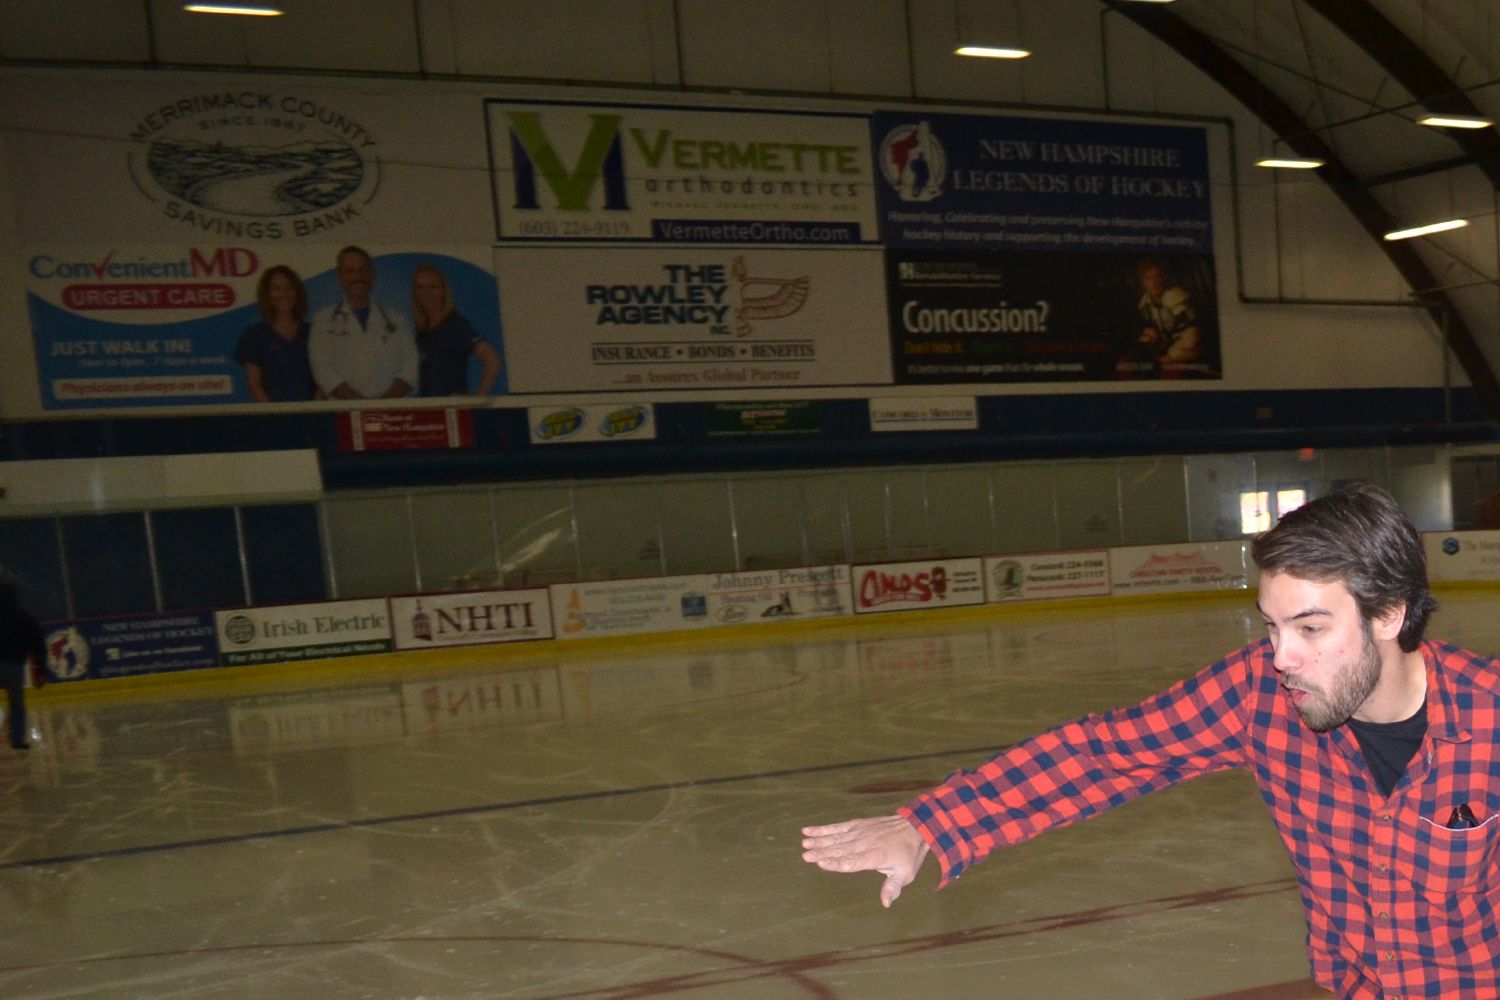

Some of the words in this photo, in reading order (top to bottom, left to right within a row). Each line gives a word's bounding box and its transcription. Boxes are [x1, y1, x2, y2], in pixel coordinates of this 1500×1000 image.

[129, 91, 273, 144] MERRIMACK
[279, 96, 377, 150] COUNTY
[630, 127, 863, 175] VERMETTE
[979, 138, 1033, 161] NEW
[1040, 142, 1182, 168] HAMPSHIRE
[645, 176, 859, 197] orthodontics
[952, 169, 1067, 193] LEGENDS
[1073, 174, 1104, 195] OF
[1110, 176, 1206, 199] HOCKEY
[162, 201, 283, 239] SAVINGS
[293, 201, 362, 237] BANK
[659, 221, 850, 242] VermetteOrtho.com
[662, 264, 726, 284] THE
[69, 289, 163, 306] URGENT
[166, 288, 227, 305] CARE
[585, 284, 729, 304] ROWLEY
[596, 304, 731, 326] AGENCY
[902, 300, 1050, 333] Concussion?
[51, 341, 99, 356] JUST
[101, 340, 161, 354] WALK
[592, 345, 672, 360] INSURANCE
[688, 345, 737, 358] BONDS
[750, 343, 816, 358] BENEFITS
[750, 367, 801, 381] Partner
[61, 382, 129, 397] Physicians
[130, 382, 175, 396] always
[713, 574, 774, 590] Johnny
[263, 617, 308, 640] Irish
[313, 611, 386, 637] Electric
[435, 602, 534, 634] NHTI
[228, 652, 250, 664] For
